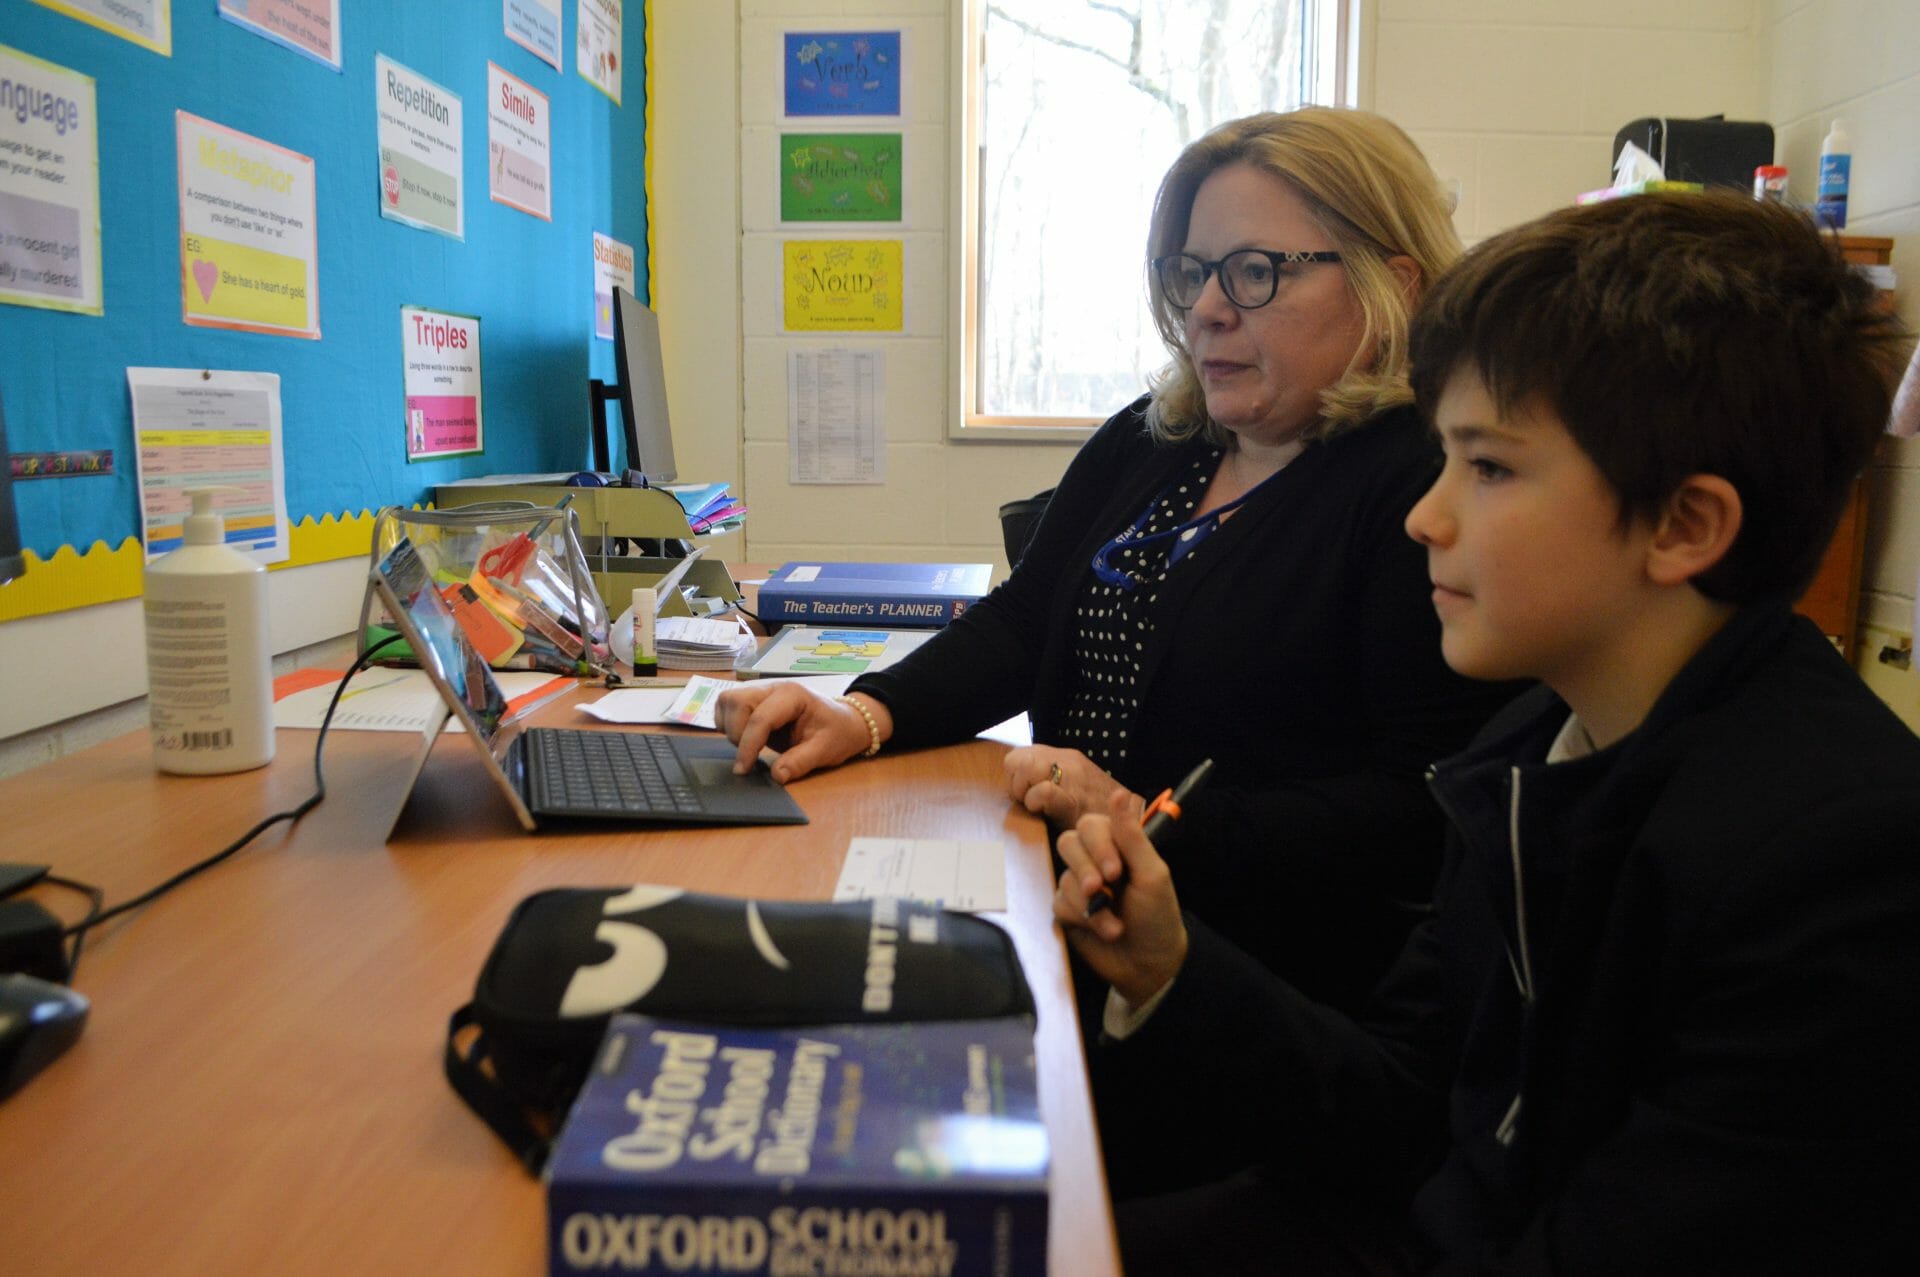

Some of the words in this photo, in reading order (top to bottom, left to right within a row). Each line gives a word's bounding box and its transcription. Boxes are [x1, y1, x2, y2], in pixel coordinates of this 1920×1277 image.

[814, 53, 868, 83] Verb
[387, 69, 449, 126] Repetition
[502, 82, 535, 124] Simile
[199, 134, 294, 195] Metaphor
[594, 237, 633, 273] Statistics
[804, 266, 873, 294] Noun
[413, 315, 467, 354] Triples
[784, 600, 807, 614] The
[812, 601, 875, 615] Teacher's
[879, 603, 943, 617] PLANNER
[602, 1029, 718, 1172] Oxford
[689, 1045, 776, 1162] School
[754, 1037, 842, 1176] Dictionary
[561, 1211, 768, 1271] OXFORD
[768, 1205, 951, 1250] SCHOOL
